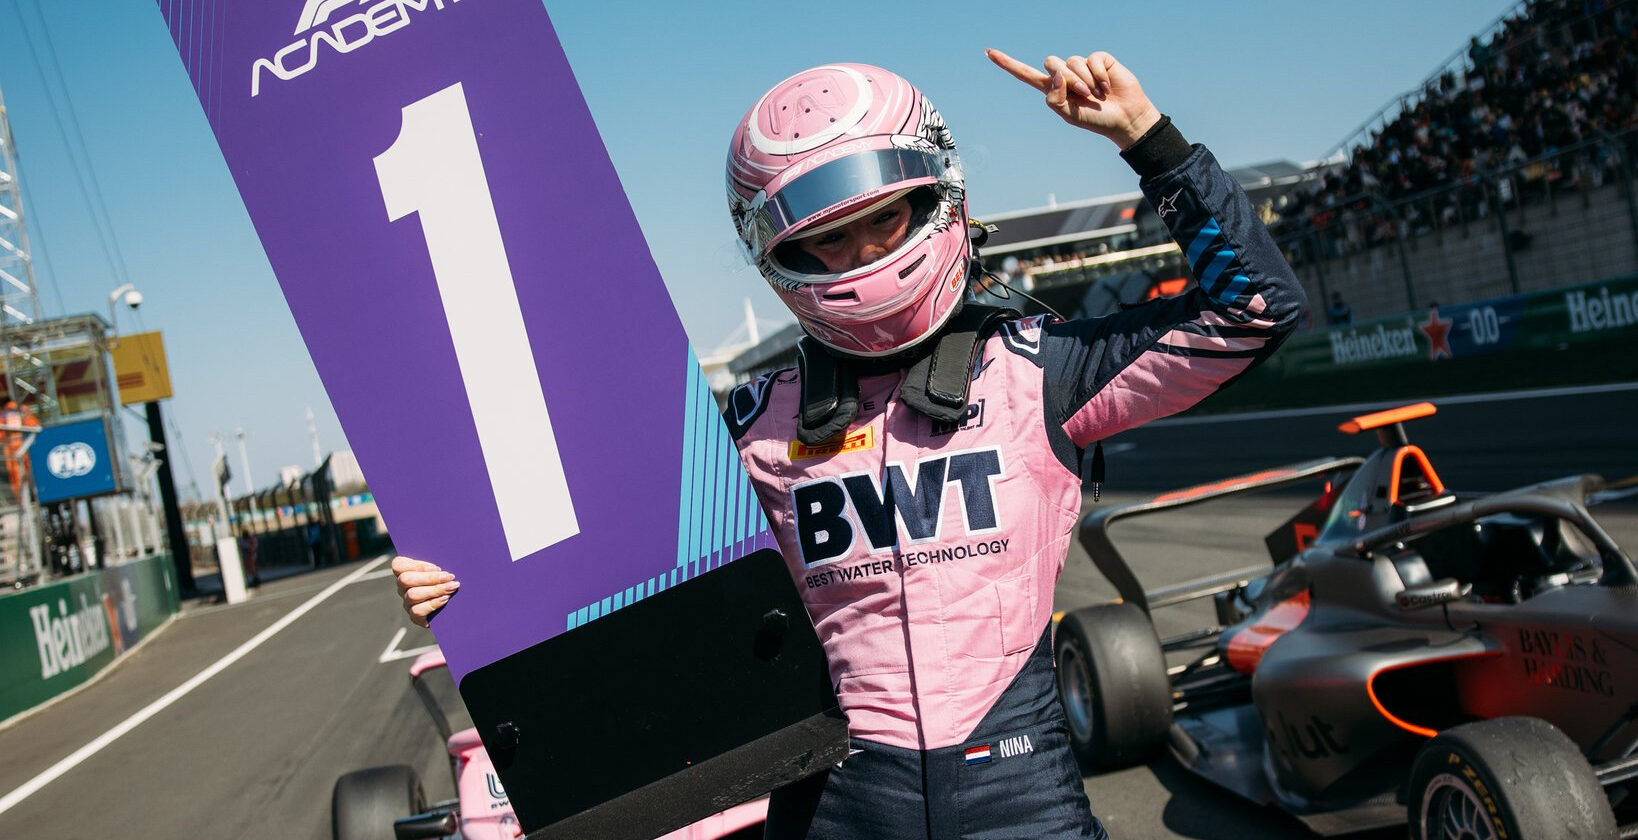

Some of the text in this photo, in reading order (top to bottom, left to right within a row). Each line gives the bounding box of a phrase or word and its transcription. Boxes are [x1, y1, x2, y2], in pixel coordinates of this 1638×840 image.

[251, 0, 461, 97] ACADEM
[805, 140, 874, 169] ACADEMY
[806, 189, 880, 223] www.mpmotorsport.com
[373, 82, 580, 561] 1
[1329, 319, 1418, 365] Heineken
[49, 446, 93, 475] FIA
[790, 445, 1005, 569] BWT
[806, 539, 1009, 588] BEST WATER TECHNOLOGY
[1000, 734, 1034, 758] NINA
[1462, 764, 1508, 840] ZERO
